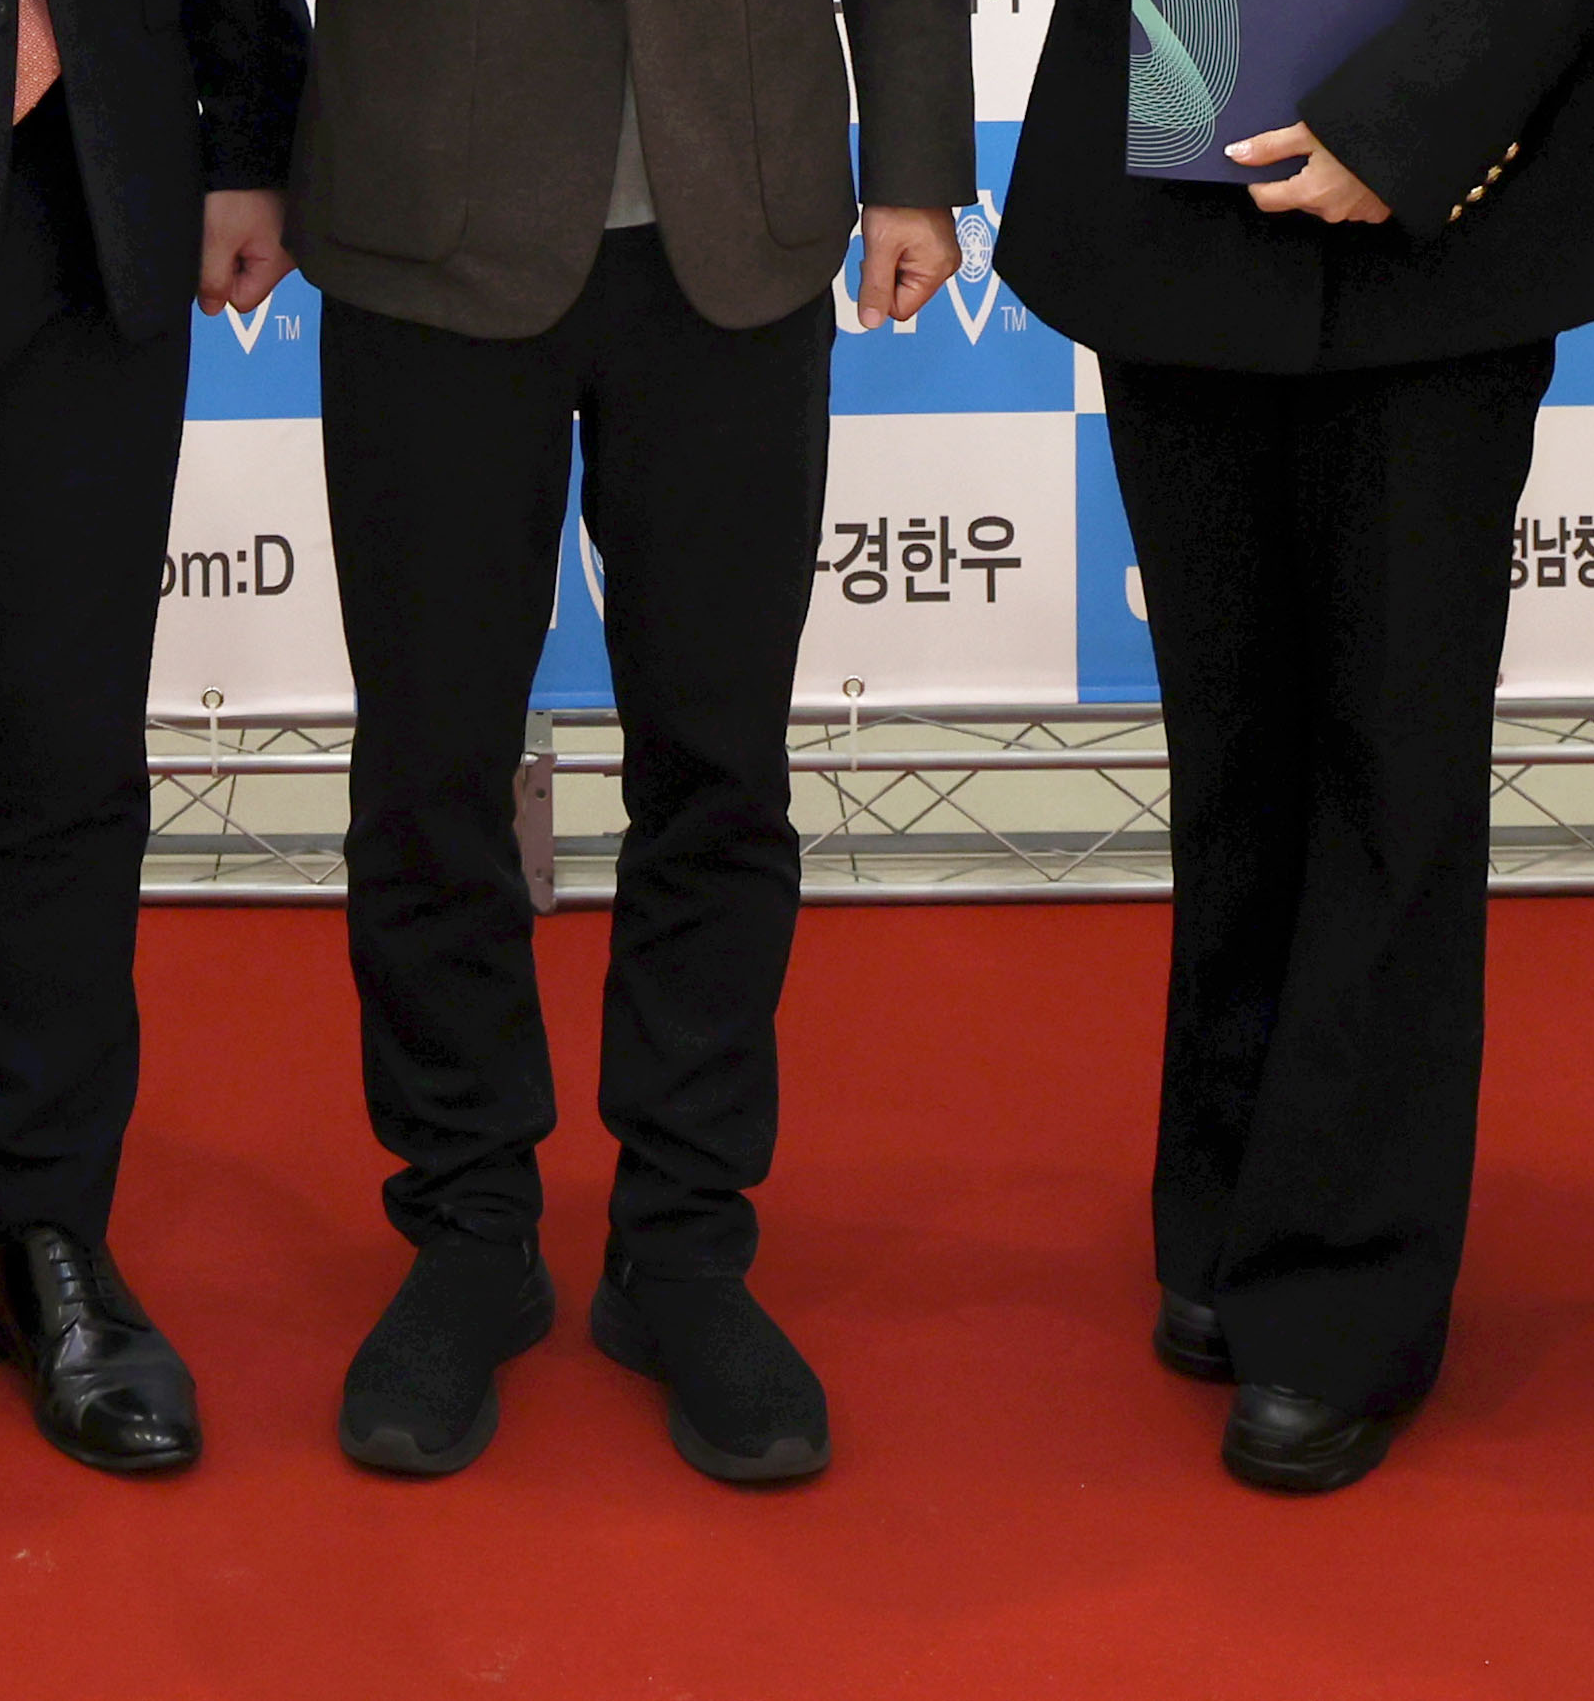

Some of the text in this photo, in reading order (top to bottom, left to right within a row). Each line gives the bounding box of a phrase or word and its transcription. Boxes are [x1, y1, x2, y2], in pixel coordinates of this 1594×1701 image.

[274, 315, 301, 341] TM
[1000, 306, 1027, 332] TM
[816, 515, 1022, 604] 경한우
